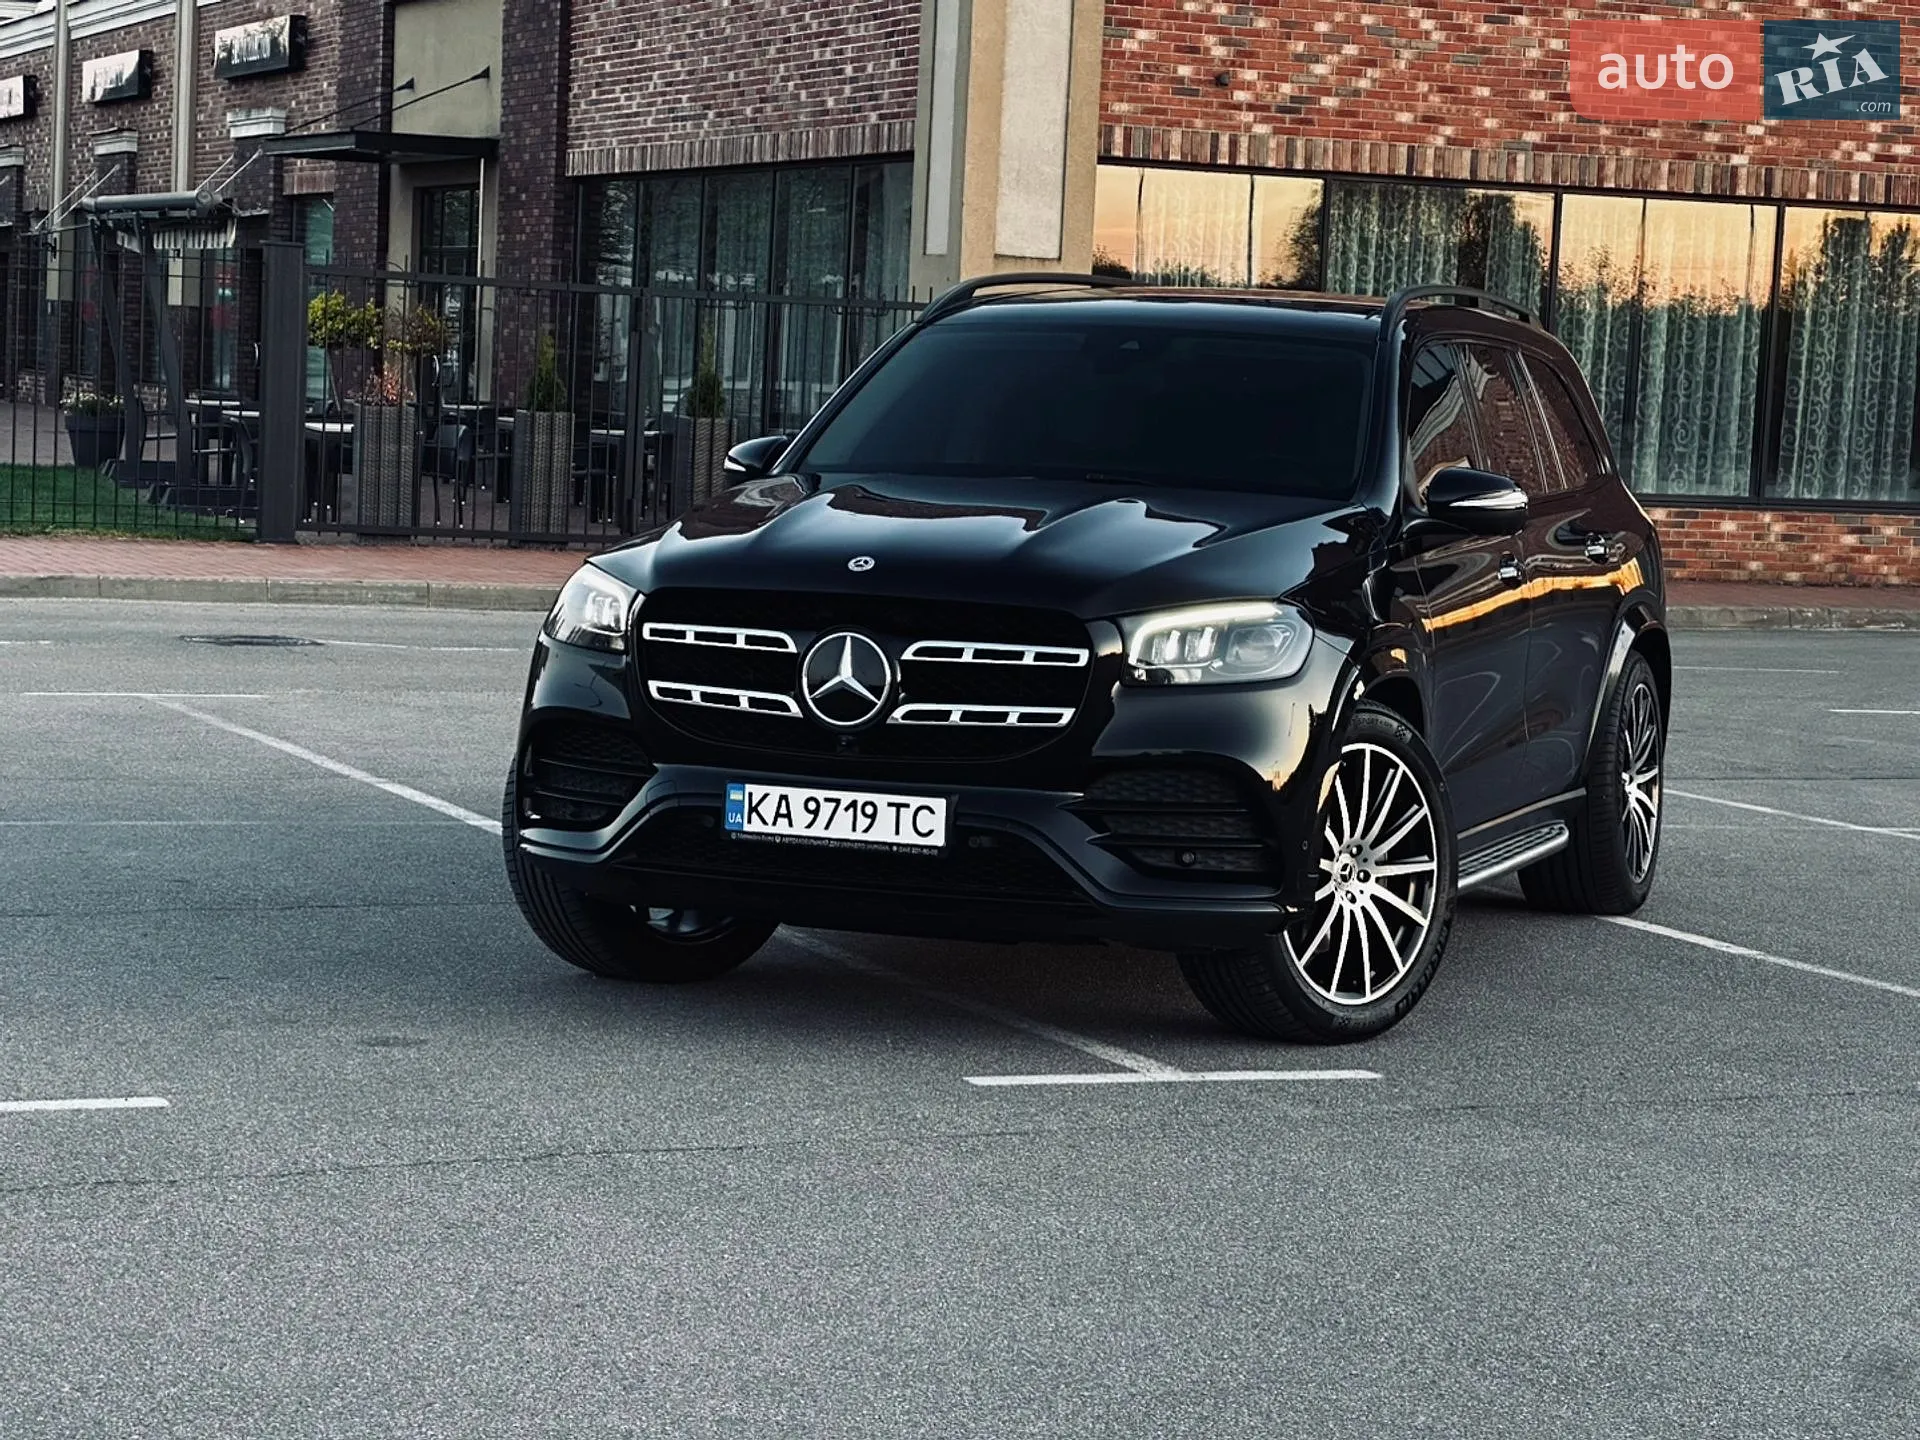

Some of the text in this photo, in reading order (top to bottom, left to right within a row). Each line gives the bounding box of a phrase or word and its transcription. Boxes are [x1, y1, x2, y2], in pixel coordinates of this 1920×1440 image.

[727, 812, 743, 824] UA
[746, 791, 936, 839] KA 9719 TC
